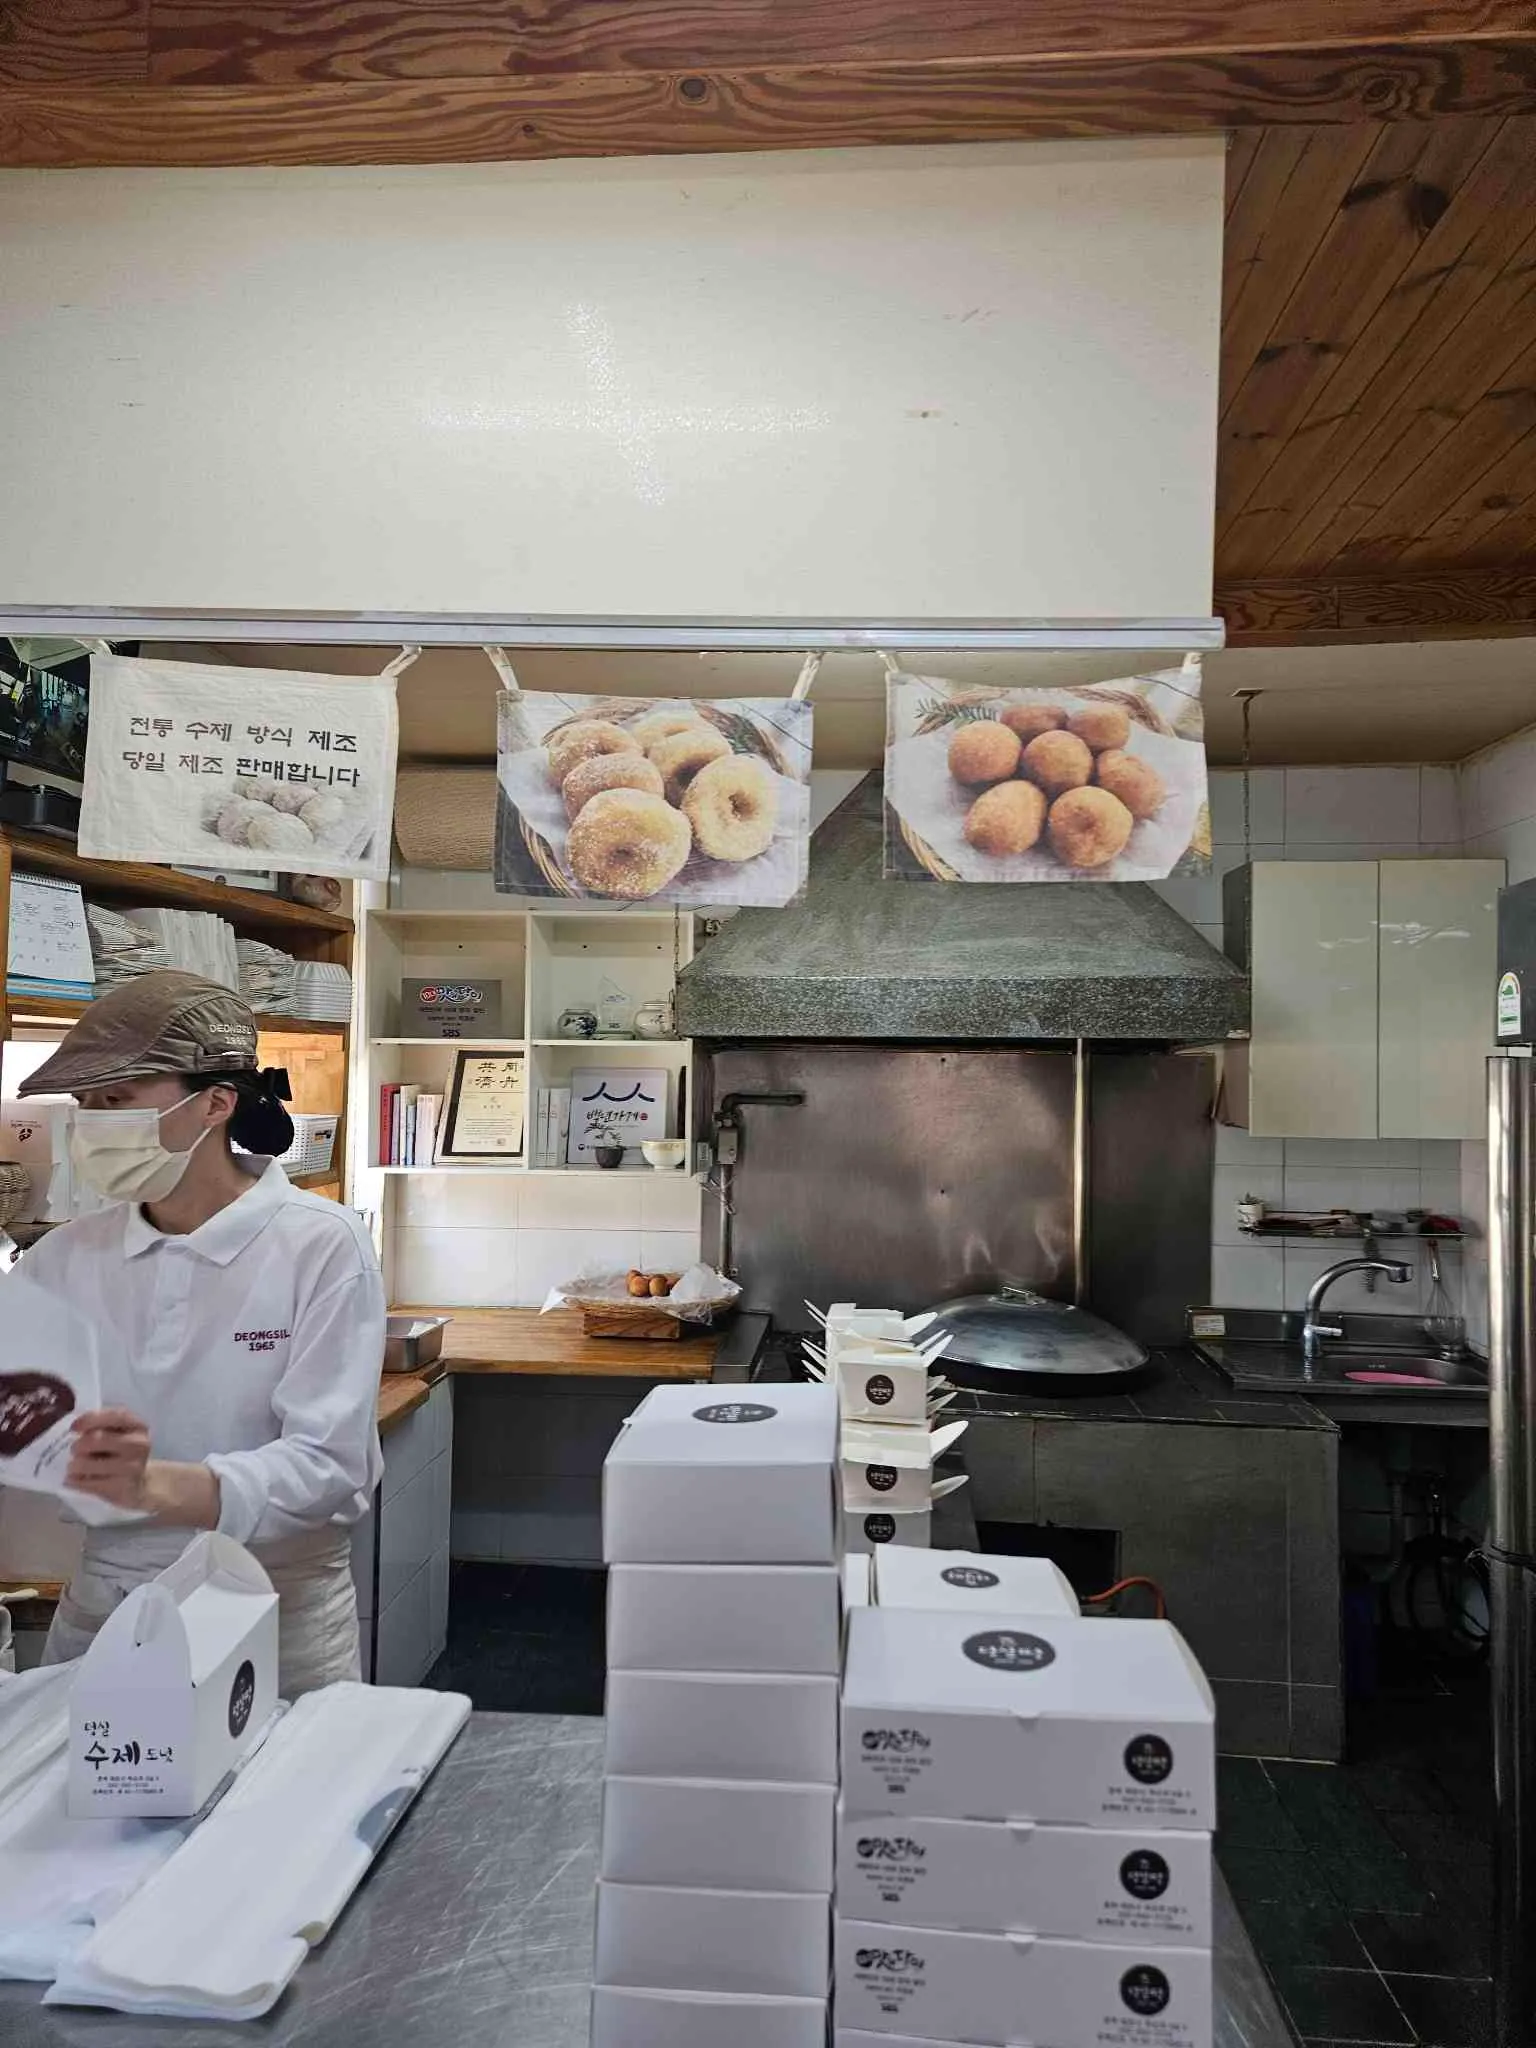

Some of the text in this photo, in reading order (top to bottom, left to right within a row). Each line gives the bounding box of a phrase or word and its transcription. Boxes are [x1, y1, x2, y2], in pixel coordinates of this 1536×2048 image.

[130, 717, 357, 752] 전통 수제 방식 제조
[122, 751, 360, 787] 당일 제조 판매합니다
[233, 1329, 291, 1342] DEONGSIL
[249, 1341, 275, 1351] 1965
[84, 1741, 173, 1770] 수제 도넛
